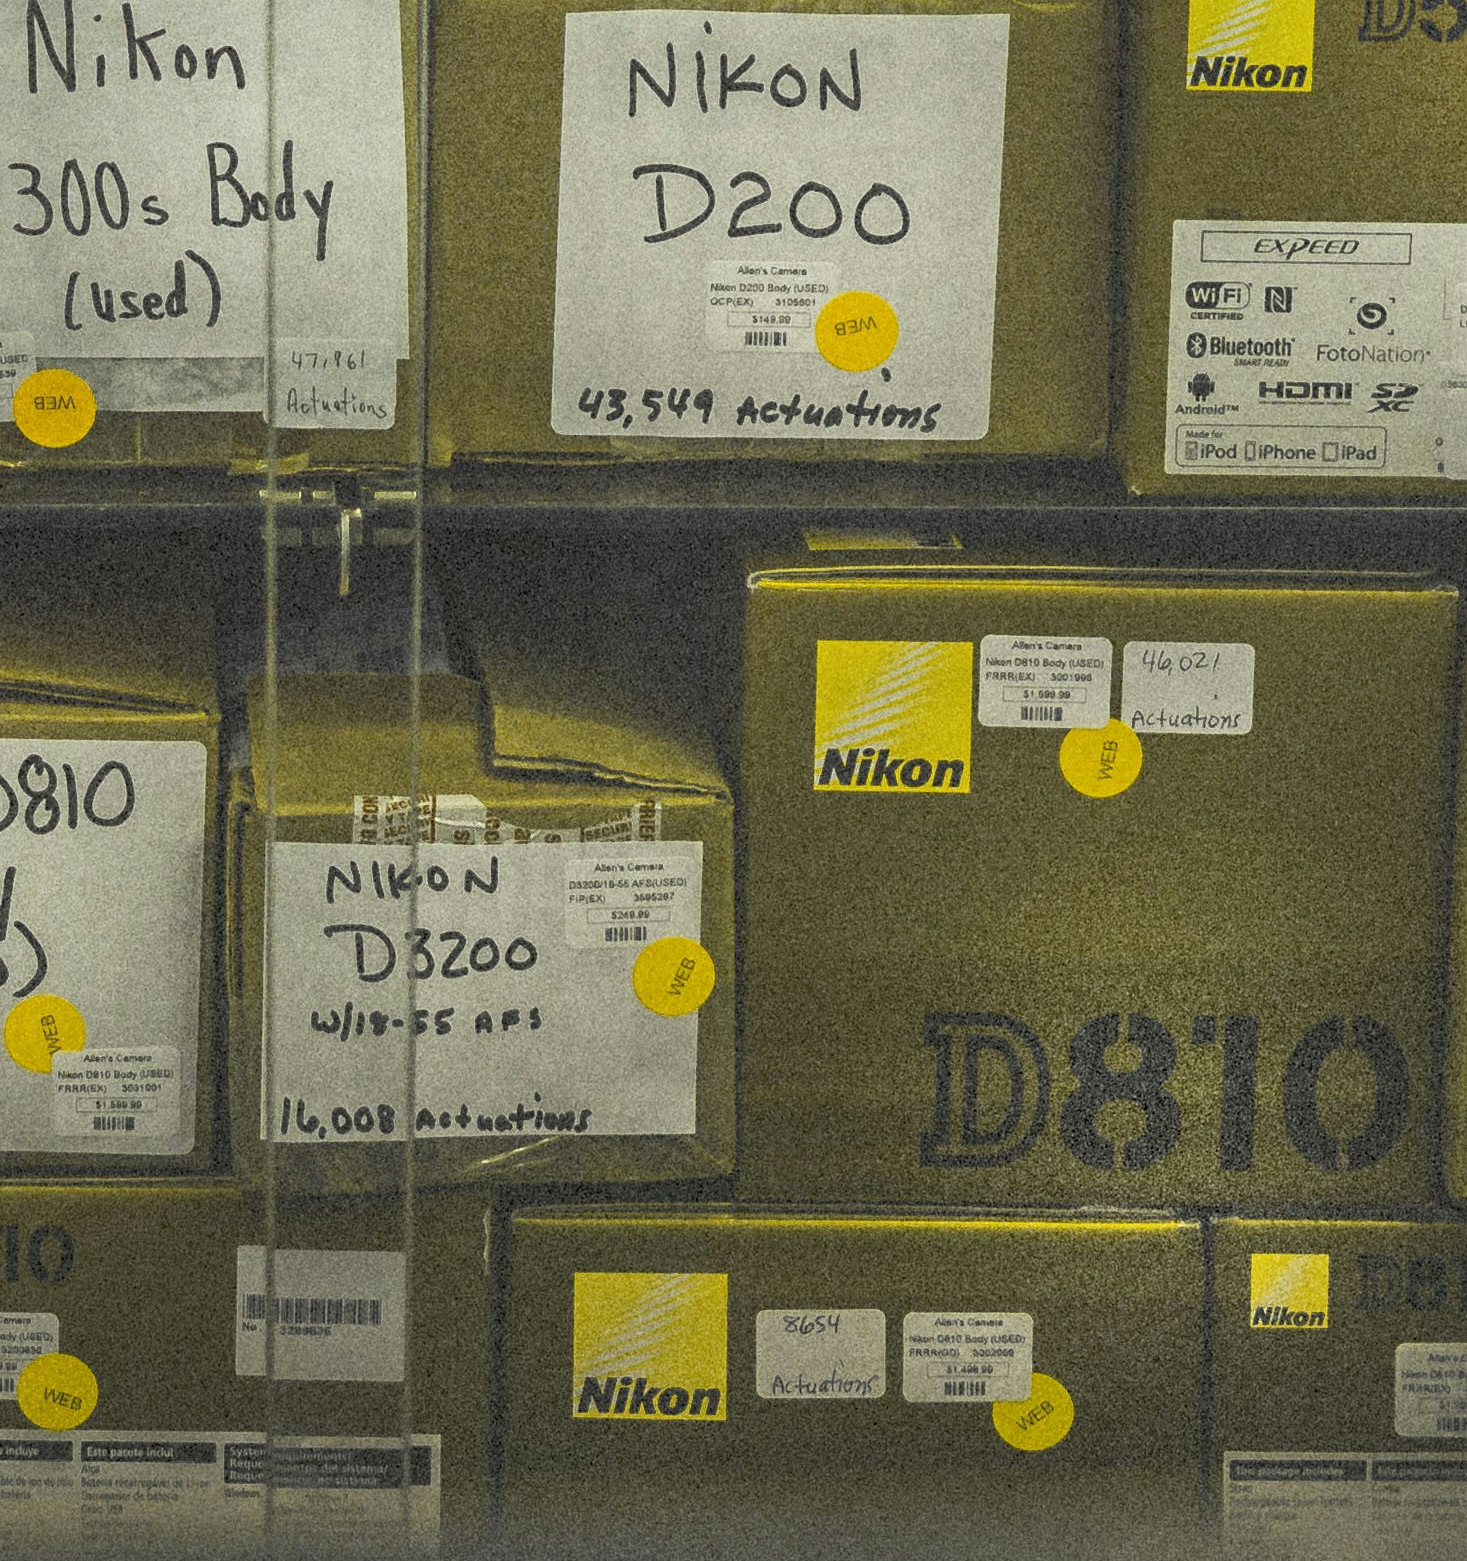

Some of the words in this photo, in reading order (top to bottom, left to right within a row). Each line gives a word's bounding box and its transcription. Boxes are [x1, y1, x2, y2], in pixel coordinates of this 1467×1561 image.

[1189, 56, 1308, 89] Nikon
[206, 138, 334, 263] Body
[631, 162, 910, 245] D200
[65, 249, 223, 330] (used)
[1210, 337, 1293, 356] Bluetooth
[1316, 344, 1425, 364] FotoNation
[578, 387, 715, 426] 43,549
[738, 366, 940, 431] Actuations
[1259, 381, 1352, 399] HDMI
[1200, 445, 1237, 459] iPod
[1258, 445, 1316, 460] iPhone
[1341, 445, 1377, 461] iPad
[819, 747, 963, 788] Nikon
[326, 856, 498, 904] NIKON
[323, 923, 538, 983] D3200
[919, 1011, 1412, 1174] D810
[1252, 1305, 1326, 1327] Nikon
[580, 1375, 720, 1414] Nikon
